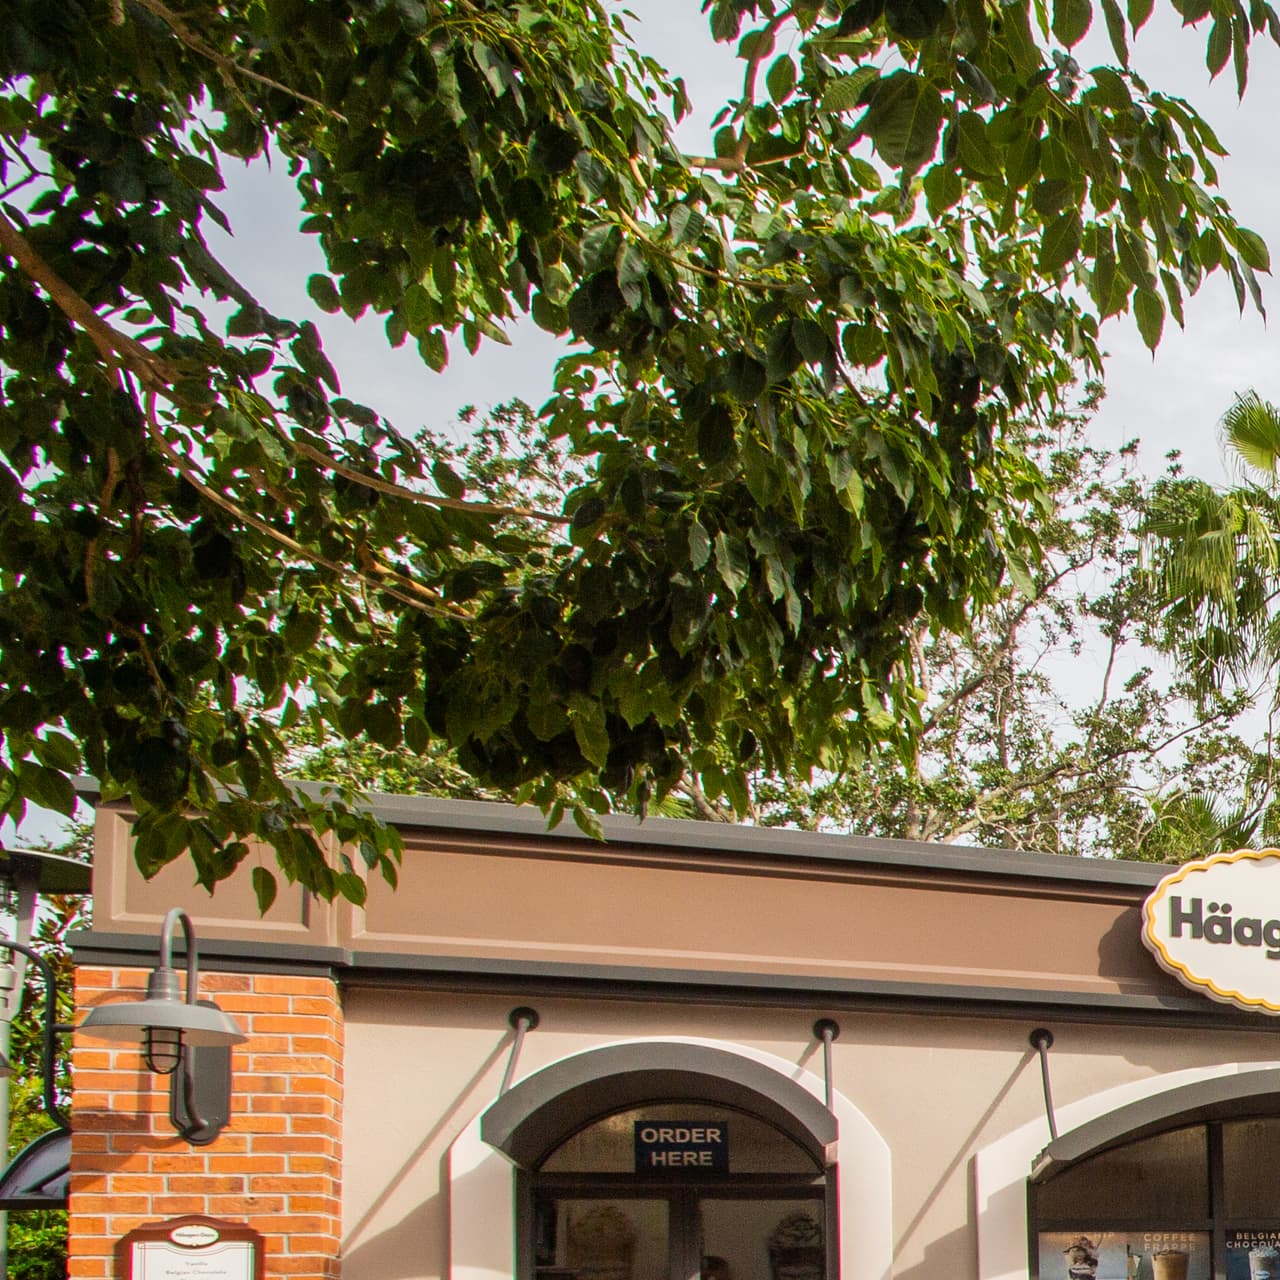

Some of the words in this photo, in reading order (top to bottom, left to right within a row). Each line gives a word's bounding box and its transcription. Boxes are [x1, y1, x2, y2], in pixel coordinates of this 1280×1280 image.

[640, 1127, 722, 1144] ORDER
[651, 1150, 713, 1167] HERE
[1143, 1233, 1196, 1243] COFFEE
